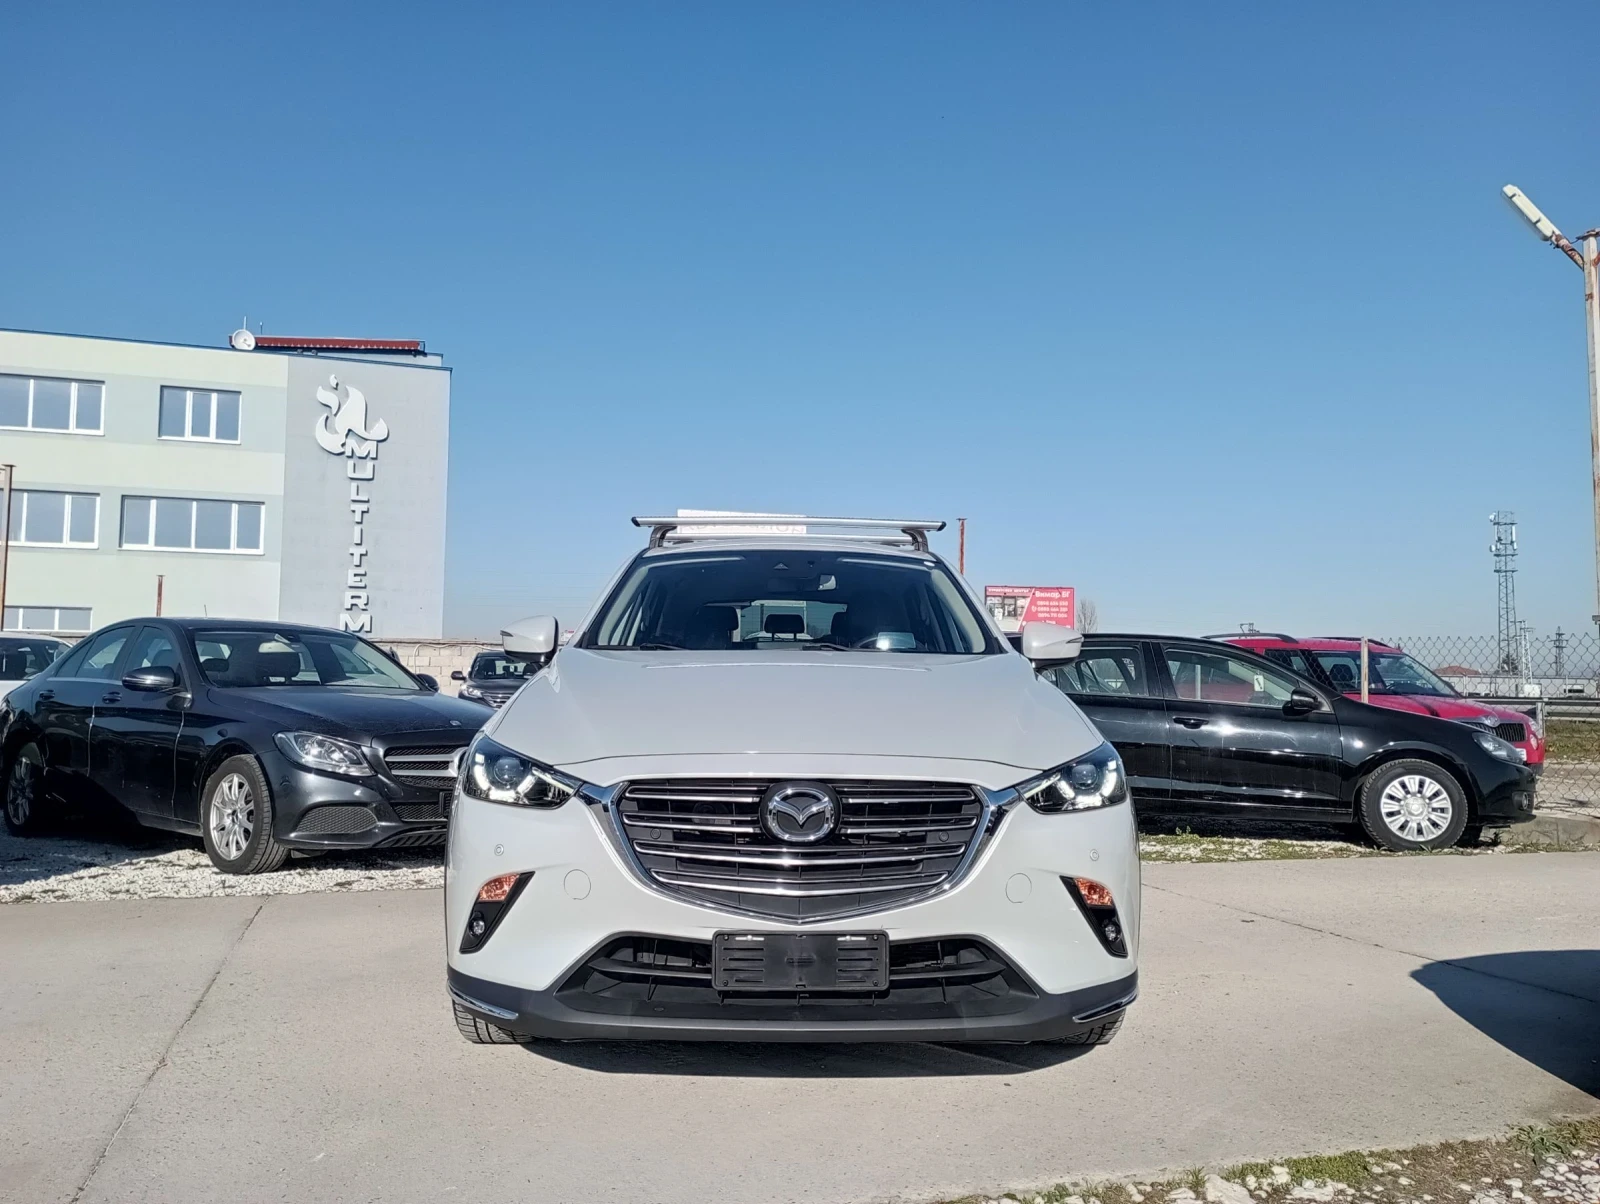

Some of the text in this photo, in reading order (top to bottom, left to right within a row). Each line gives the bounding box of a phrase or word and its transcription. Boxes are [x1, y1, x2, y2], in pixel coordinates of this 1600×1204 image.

[340, 438, 378, 633] MULTITERM
[1035, 590, 1060, 599] Вимар
[1062, 590, 1071, 598] БГ
